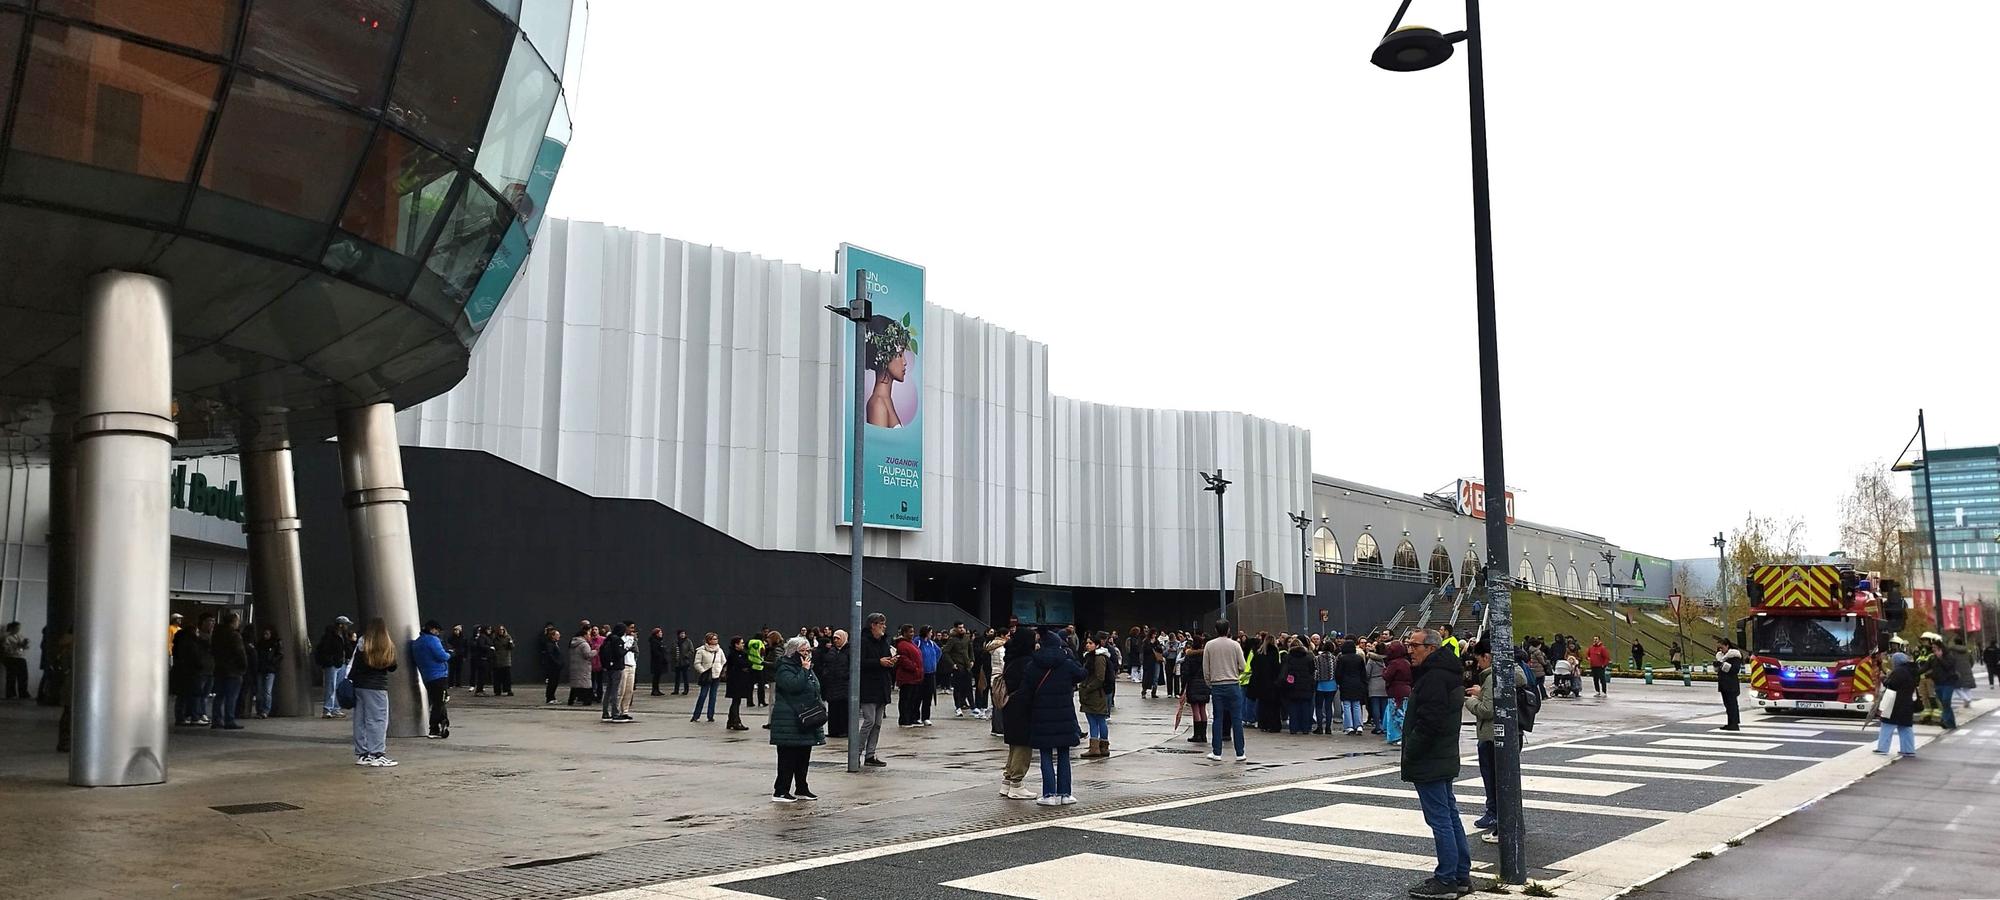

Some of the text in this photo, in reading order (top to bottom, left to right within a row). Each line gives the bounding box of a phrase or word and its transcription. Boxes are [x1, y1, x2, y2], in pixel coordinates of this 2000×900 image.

[866, 280, 889, 295] TIDO
[878, 465, 919, 479] TAUPADA
[883, 476, 919, 489] BATERA
